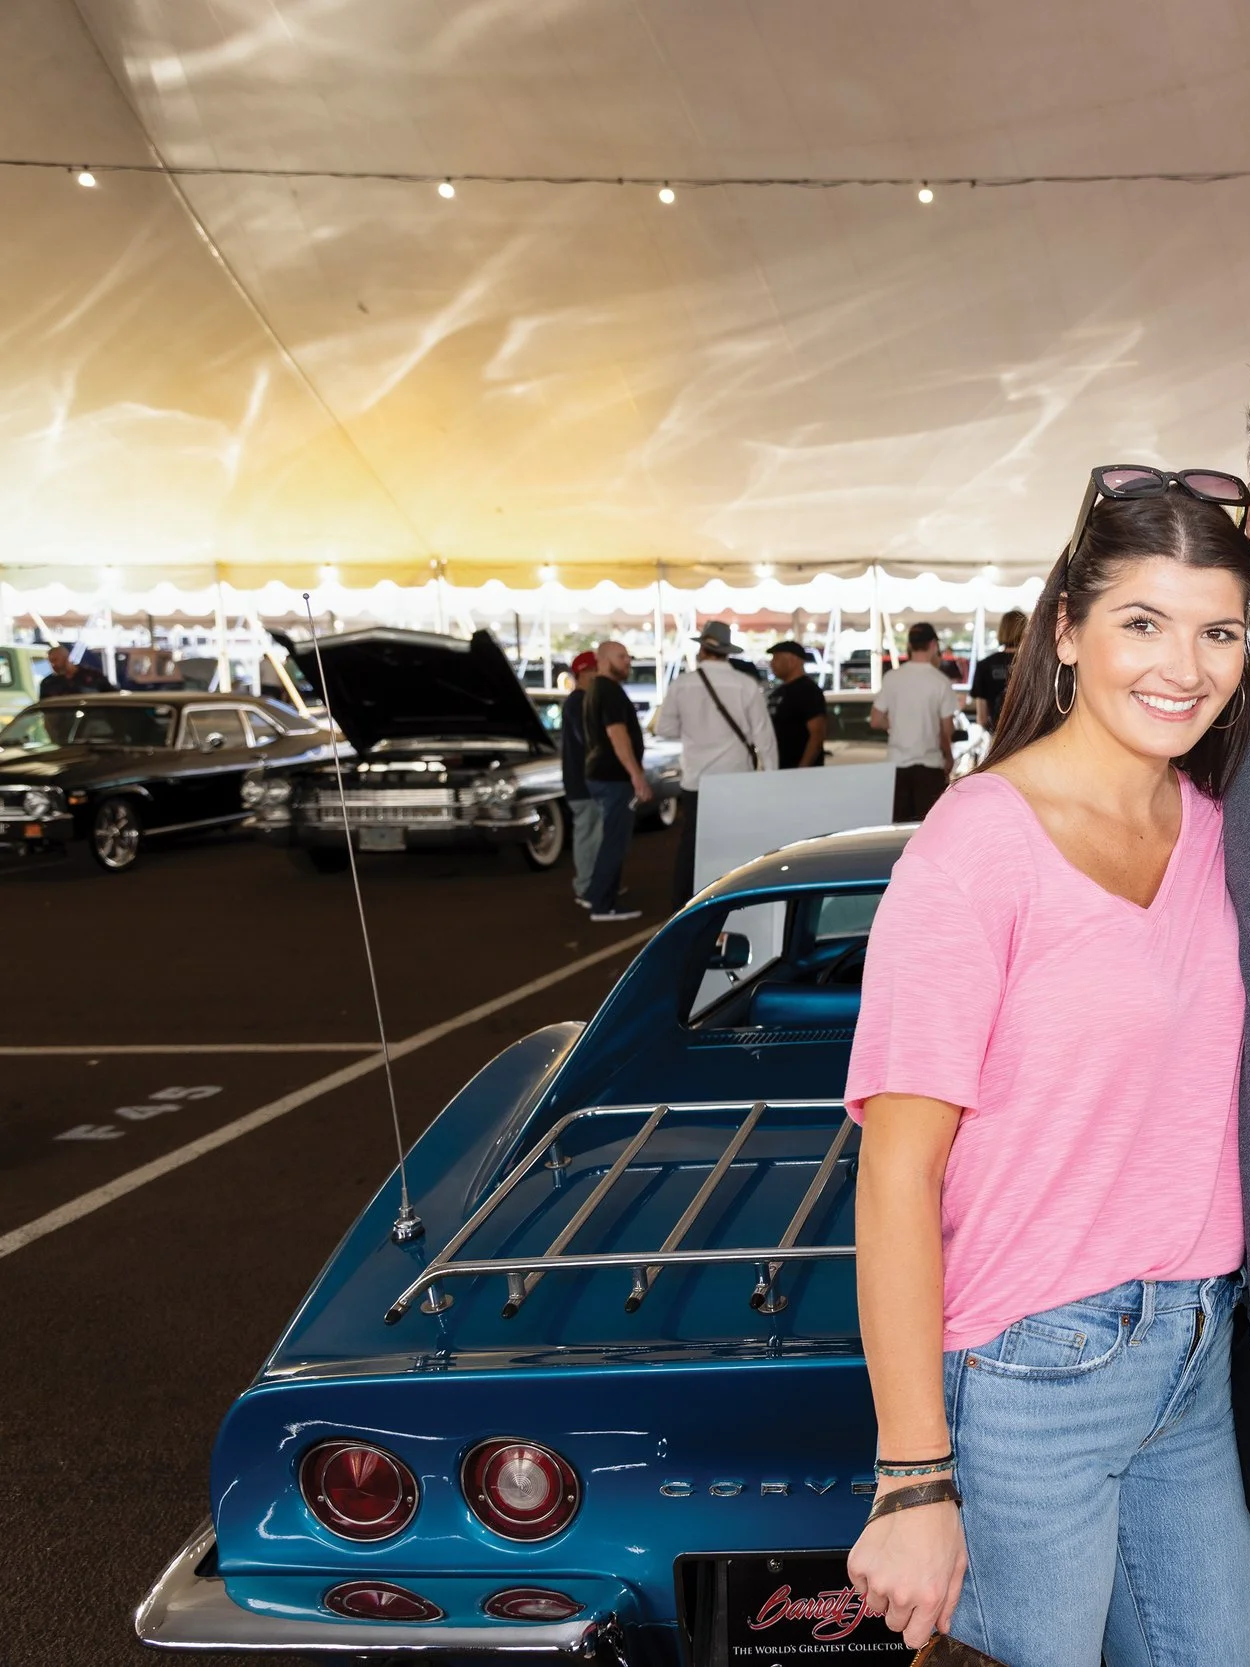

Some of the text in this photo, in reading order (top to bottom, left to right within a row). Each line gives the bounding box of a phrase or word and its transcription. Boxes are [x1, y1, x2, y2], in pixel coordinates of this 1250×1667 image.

[733, 1646, 753, 1655] THE
[755, 1645, 797, 1654] WORLD'S
[799, 1643, 846, 1653] GREATEST
[848, 1643, 904, 1652] COLLECTOR
